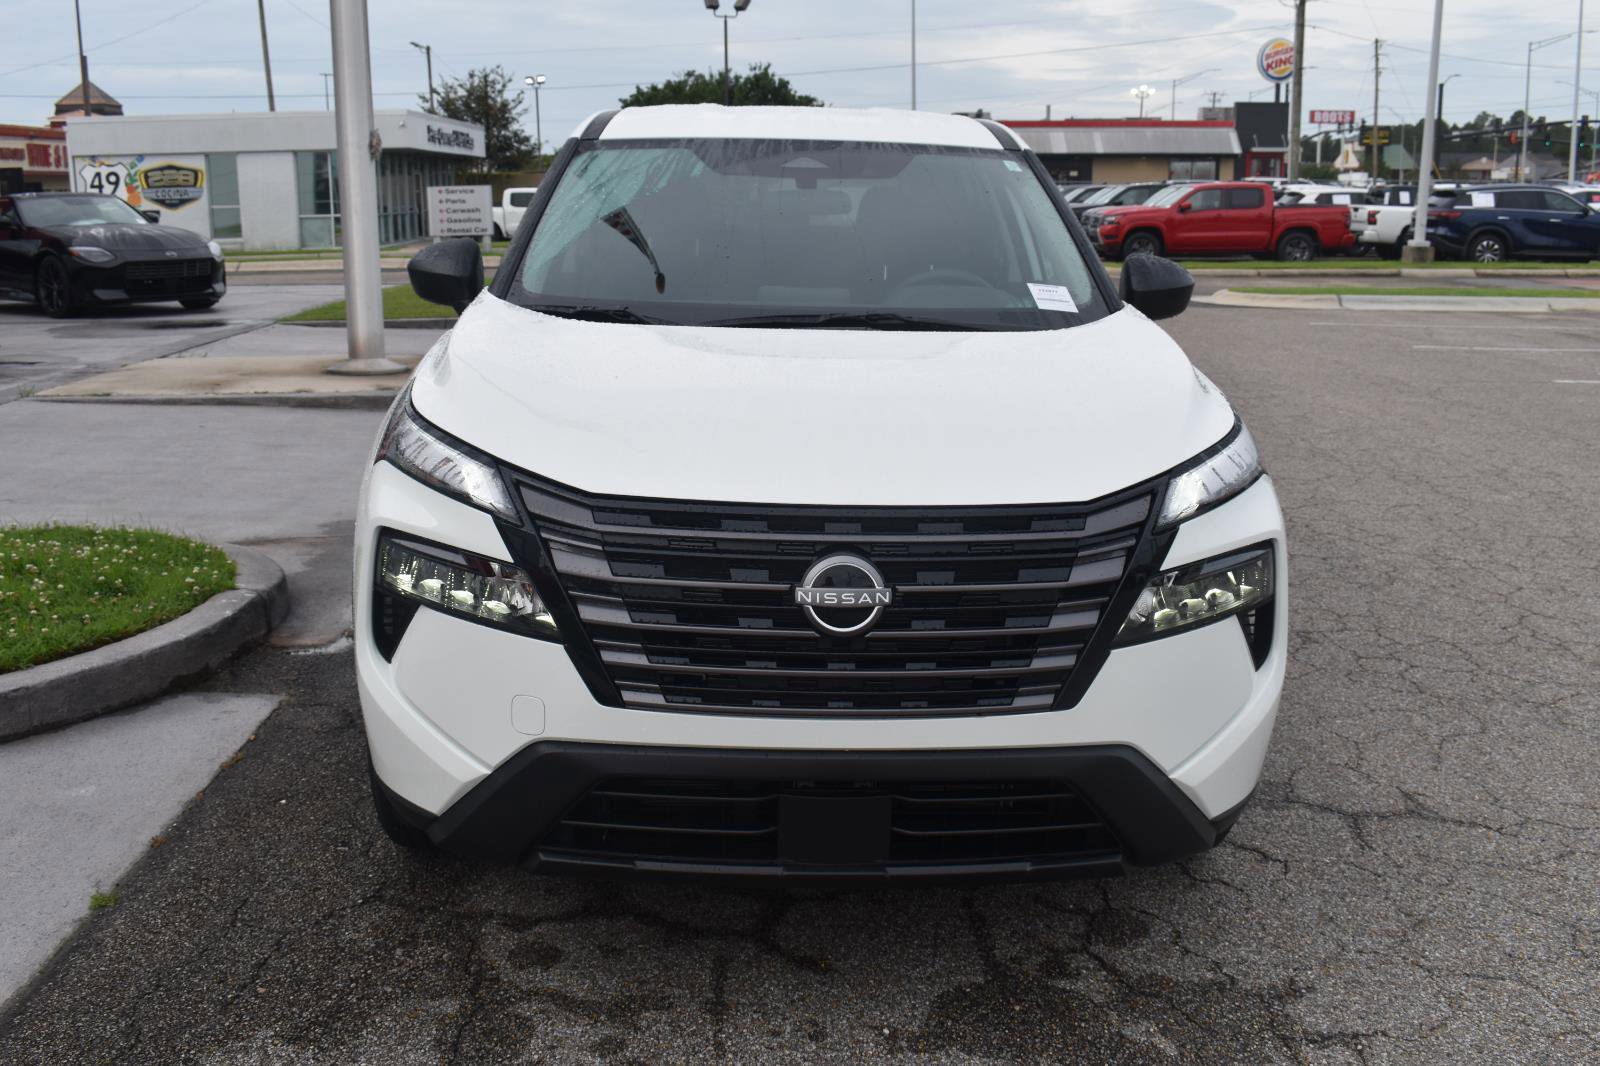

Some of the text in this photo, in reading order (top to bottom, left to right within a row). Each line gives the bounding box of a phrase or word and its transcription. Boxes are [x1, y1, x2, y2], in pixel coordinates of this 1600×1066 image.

[1314, 111, 1351, 123] BOOTS
[90, 171, 120, 196] 49
[154, 188, 190, 199] COCINA
[797, 590, 890, 604] NISSAN
